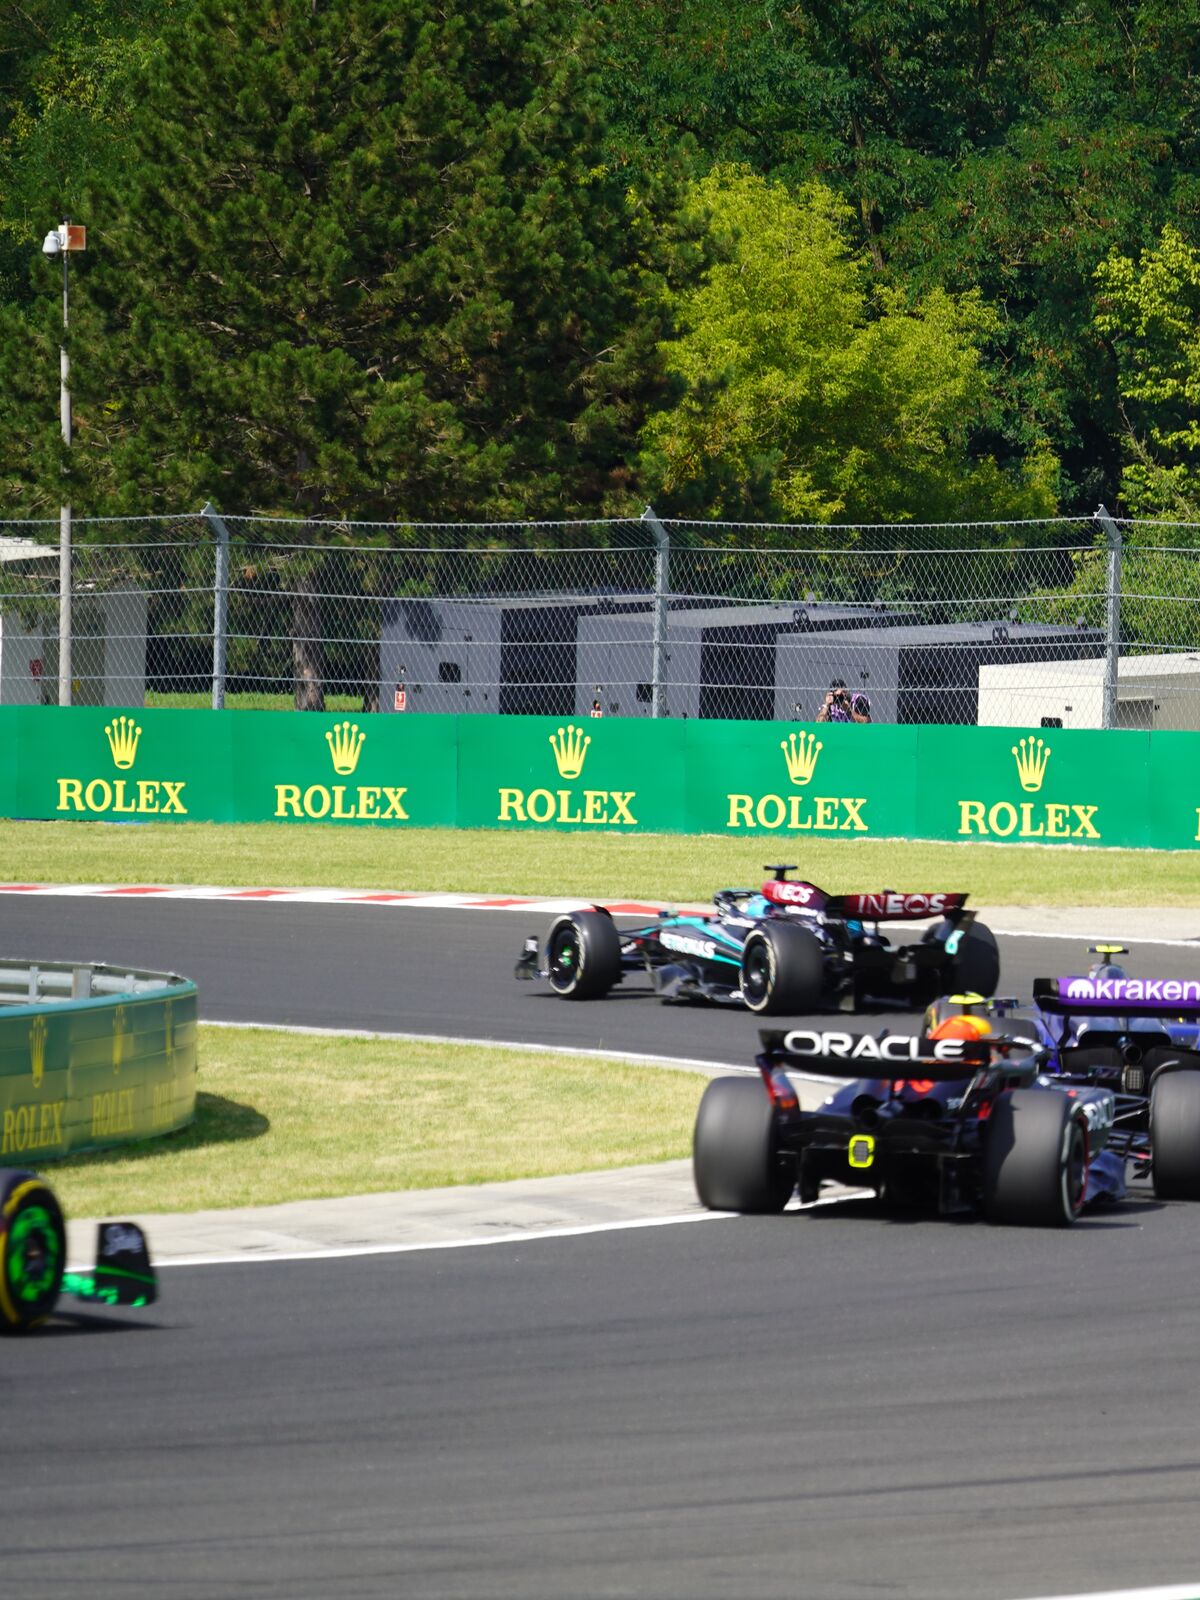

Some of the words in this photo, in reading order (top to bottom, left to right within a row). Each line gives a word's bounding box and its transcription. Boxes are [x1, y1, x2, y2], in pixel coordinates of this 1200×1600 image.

[57, 779, 188, 814] ROLEX
[274, 784, 410, 819] ROLEX
[498, 789, 637, 825] ROLEX
[727, 795, 868, 832] ROLEX
[958, 801, 1101, 838] ROLEX
[856, 893, 947, 914] INEOS
[783, 1029, 966, 1063] ORACLE
[1, 1100, 66, 1155] ROLEX
